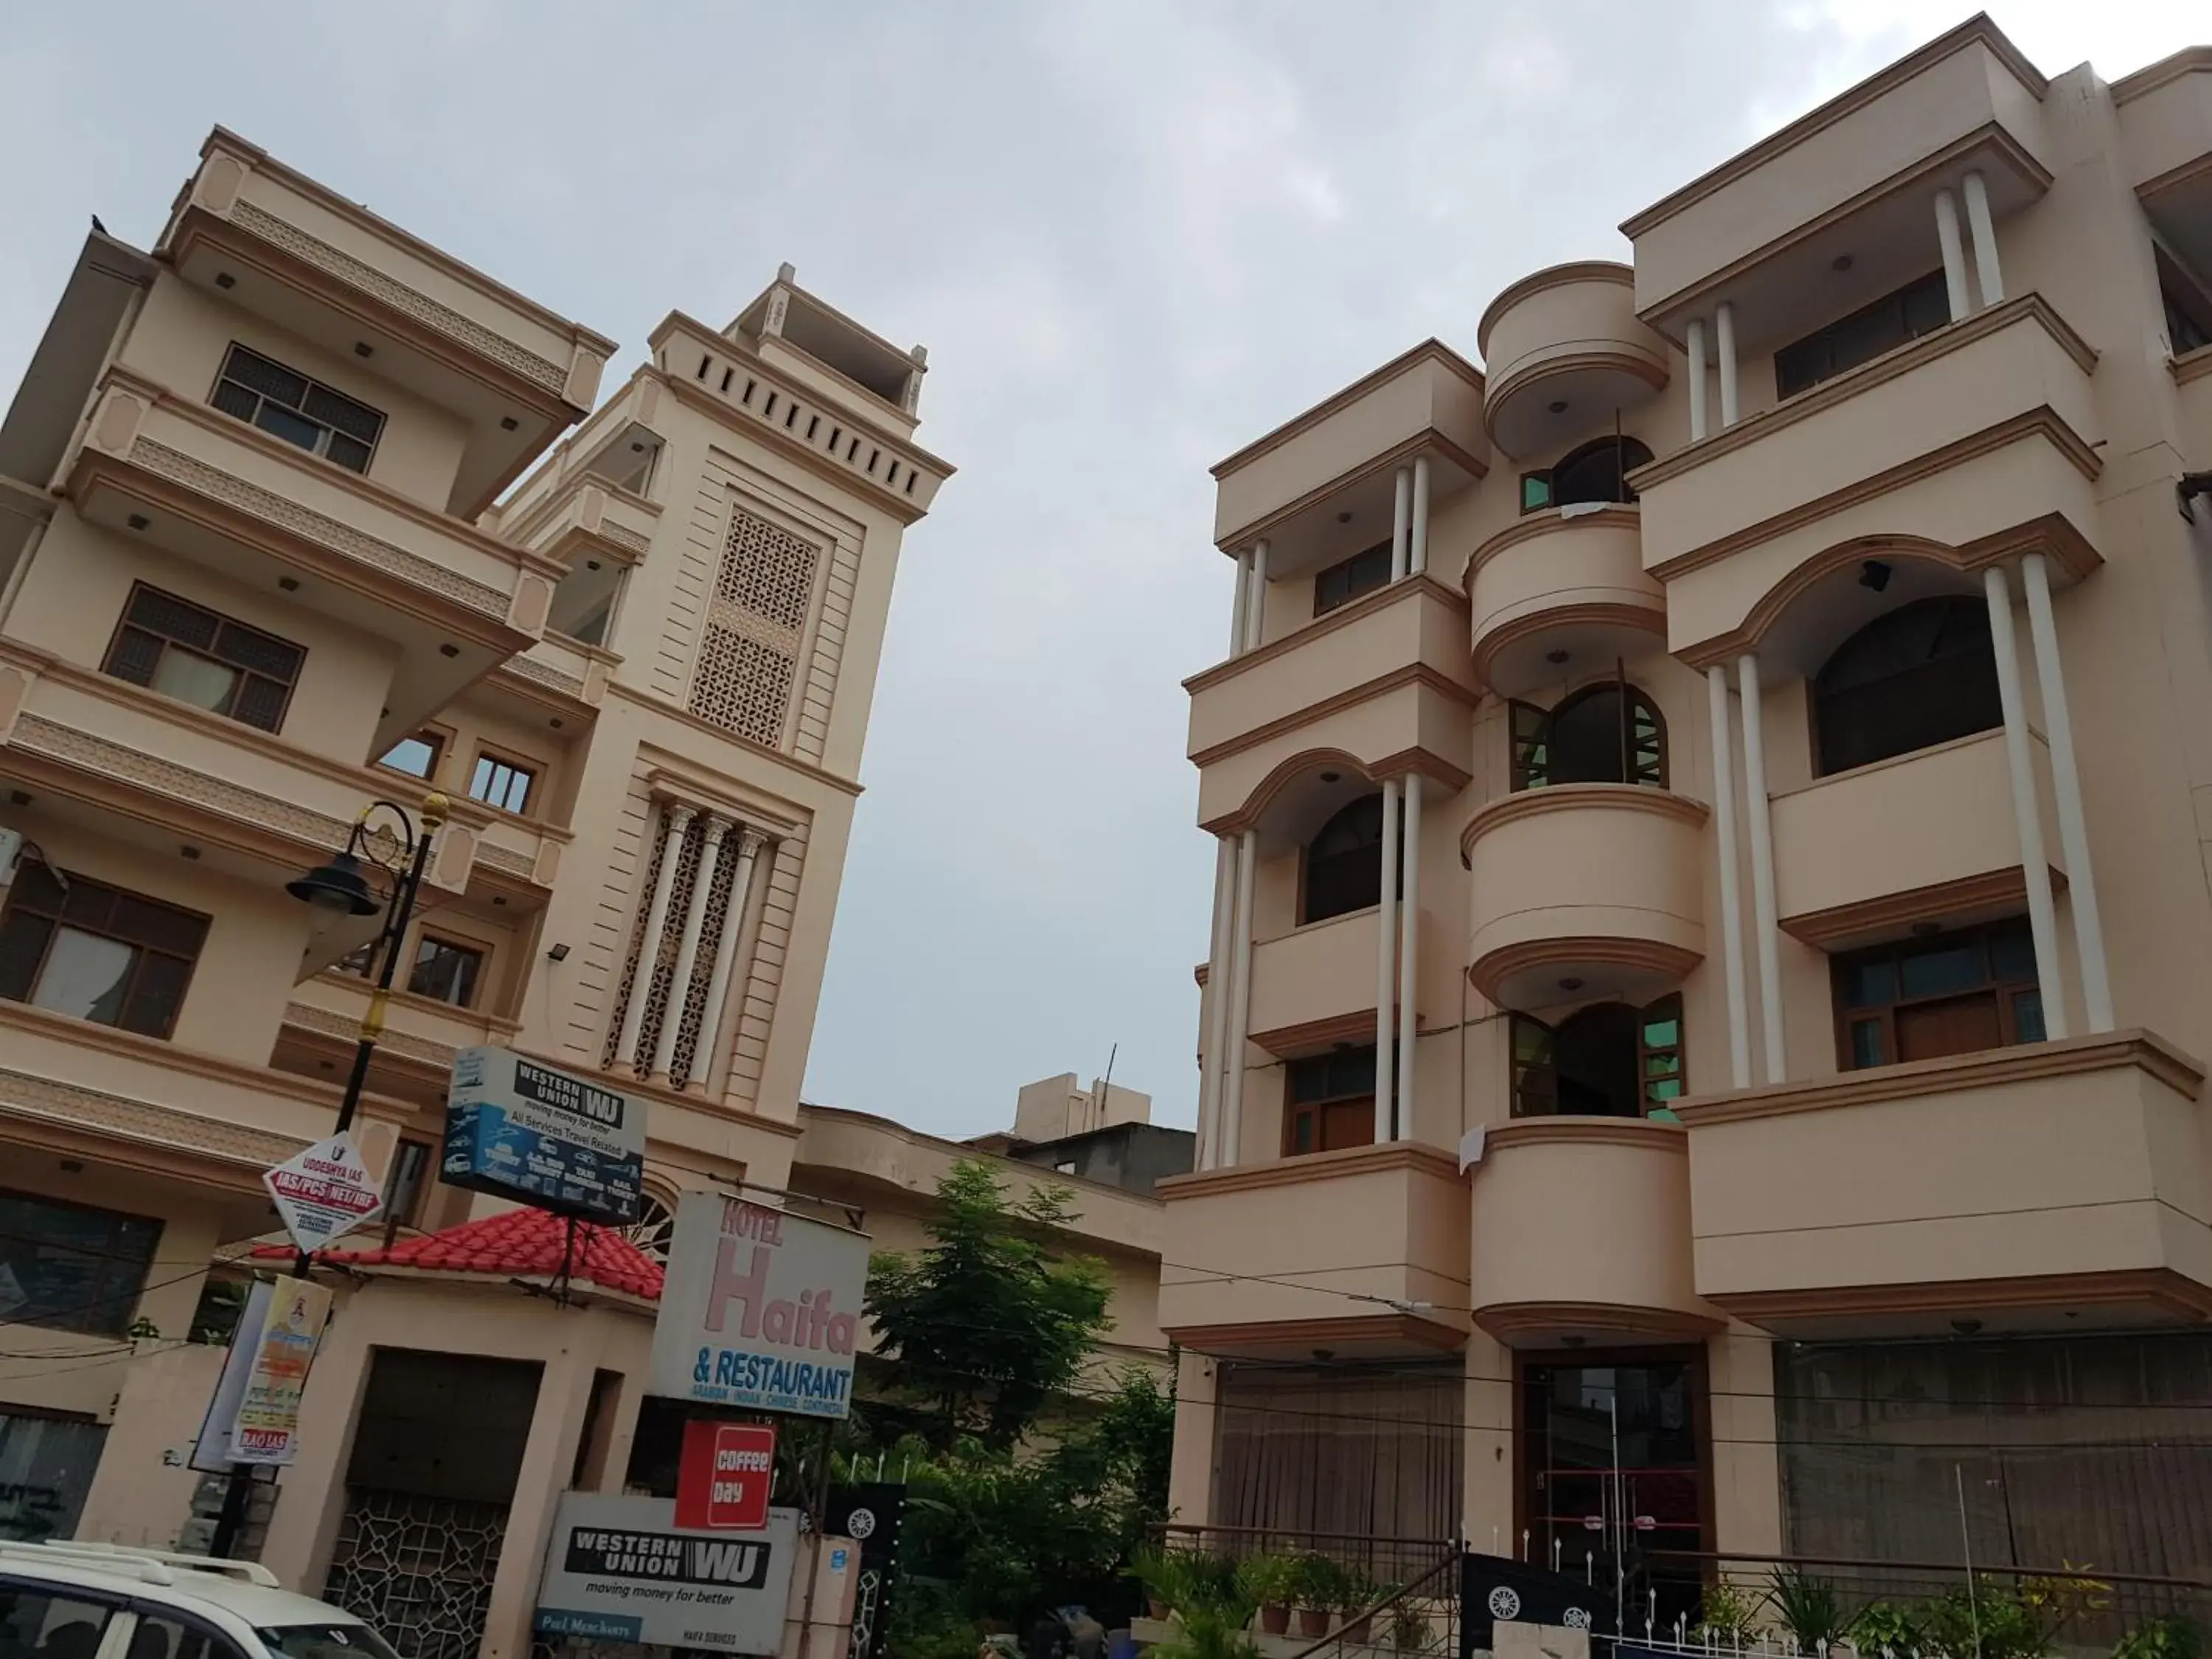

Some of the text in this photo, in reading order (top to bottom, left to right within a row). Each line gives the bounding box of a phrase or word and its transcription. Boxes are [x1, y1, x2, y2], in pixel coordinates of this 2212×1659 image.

[519, 1064, 580, 1096] WESTERN
[538, 1086, 579, 1109] UNION
[586, 1089, 619, 1123] WU
[525, 1113, 563, 1136] Services
[565, 1127, 589, 1144] Travel
[720, 1200, 784, 1247] HOTEL
[704, 1237, 860, 1356] Haifa
[693, 1346, 851, 1402] & RESTAURANT
[577, 1531, 682, 1558] WESTERN
[605, 1555, 680, 1576] UNION
[694, 1542, 759, 1583] WU
[585, 1582, 735, 1605] moving money for better
